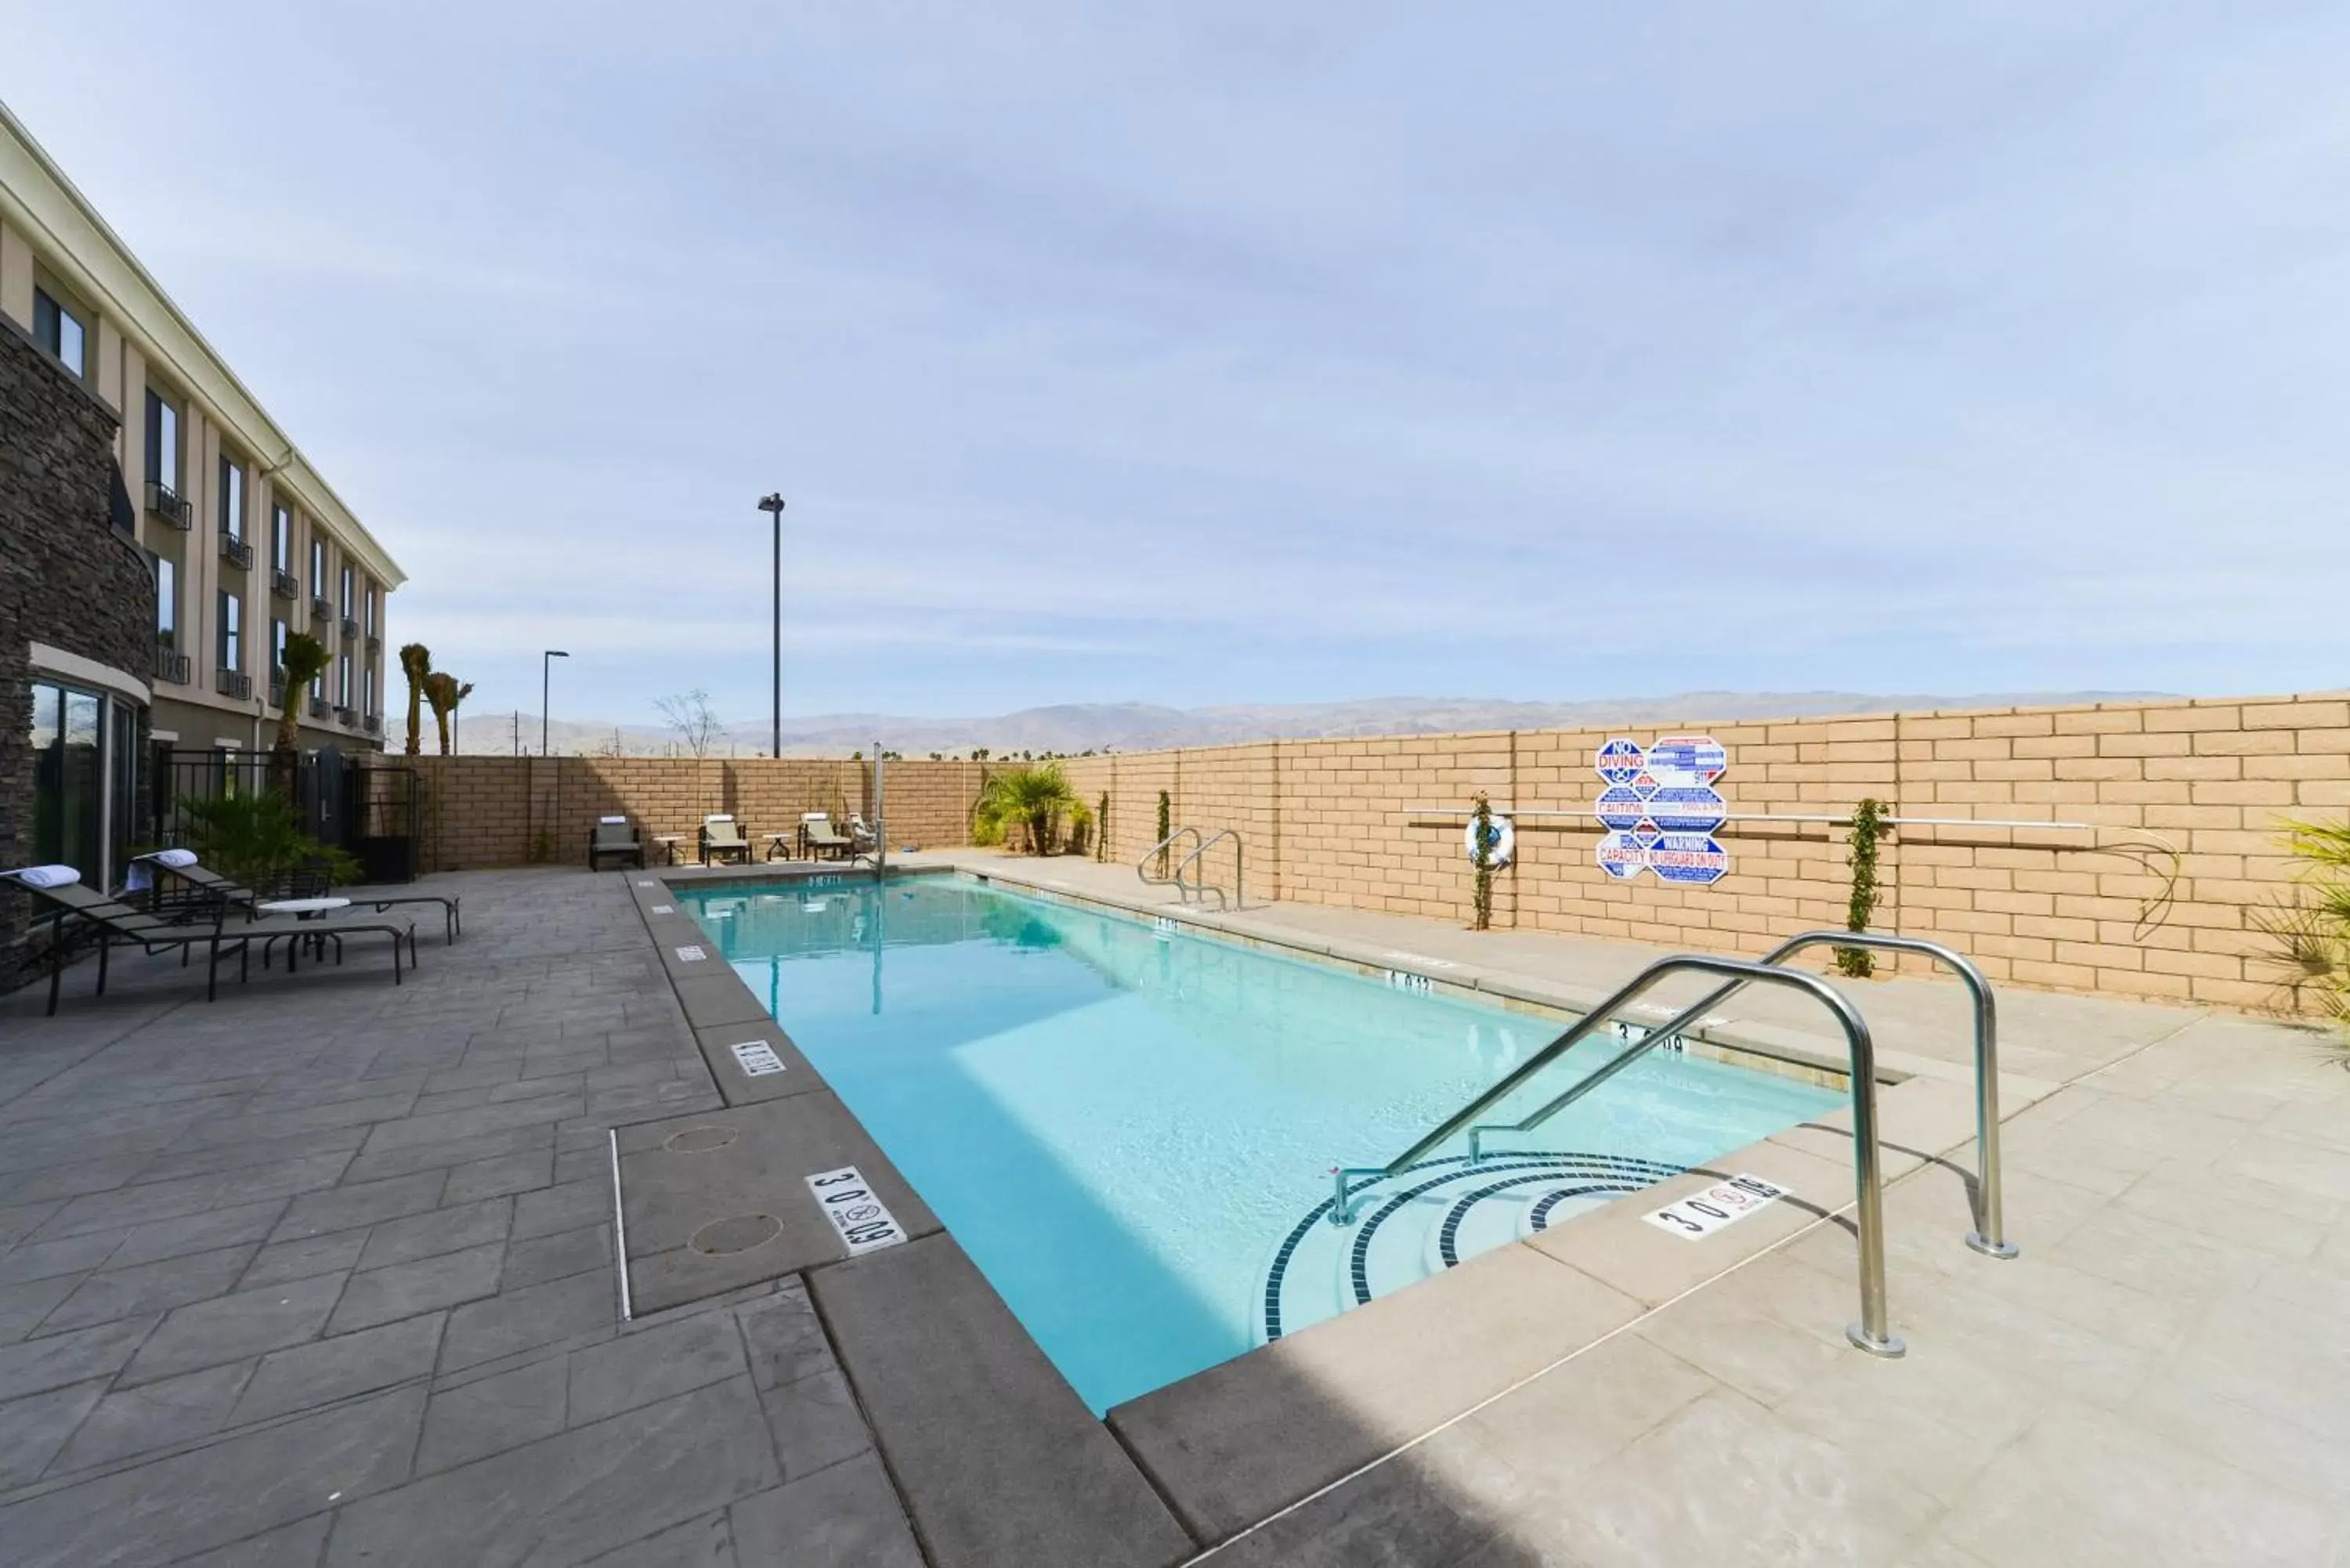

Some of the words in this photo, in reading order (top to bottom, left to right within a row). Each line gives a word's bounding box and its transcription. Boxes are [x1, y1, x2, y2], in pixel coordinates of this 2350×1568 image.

[1613, 741, 1632, 754] NO
[1599, 755, 1644, 768] DIVING
[1599, 803, 1643, 813] CAUTION
[1665, 836, 1708, 851] WARNING
[1601, 849, 1645, 862] CAPACITY
[1650, 852, 1658, 864] NO
[1660, 852, 1694, 865] LIFEGUARD
[1697, 853, 1706, 866] ON
[1708, 854, 1724, 867] DUTY
